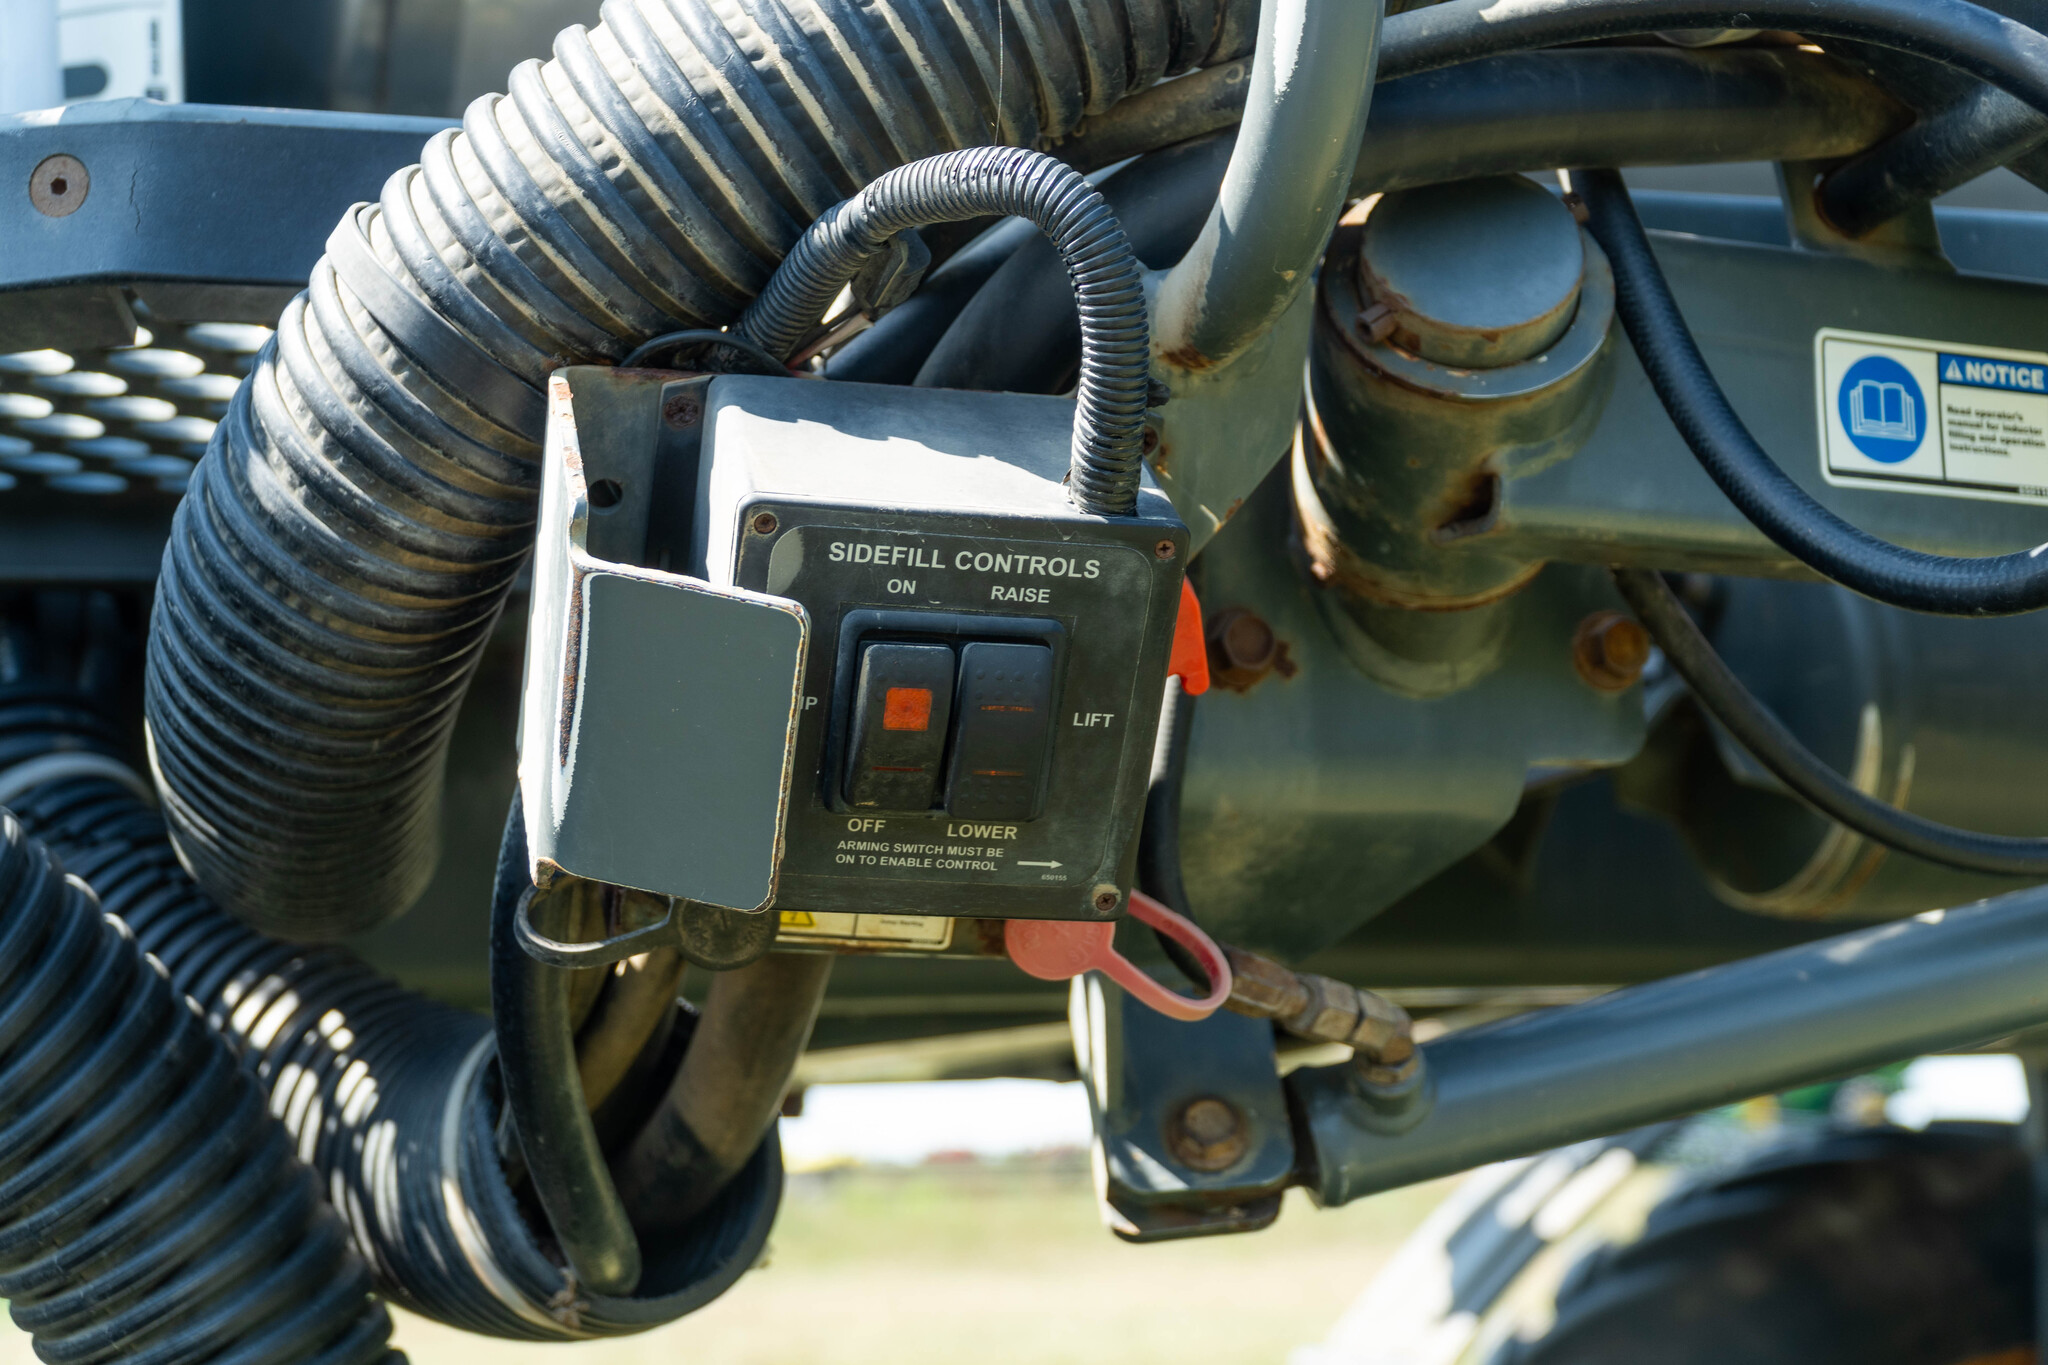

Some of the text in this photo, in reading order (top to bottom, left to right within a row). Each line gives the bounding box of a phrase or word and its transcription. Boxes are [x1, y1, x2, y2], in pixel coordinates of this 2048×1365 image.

[1965, 361, 2045, 390] NOTICE
[828, 541, 1100, 579] SIDEFILL CONTROLS
[887, 578, 916, 595] ON
[990, 586, 1051, 604] RAISE
[1073, 712, 1114, 728] LIFT
[847, 818, 887, 834] OFF
[946, 823, 1018, 840] LOWER
[836, 840, 1004, 858] ARMING SWITCH MUST BE
[835, 854, 998, 871] ON TO ENABLE CONTROL
